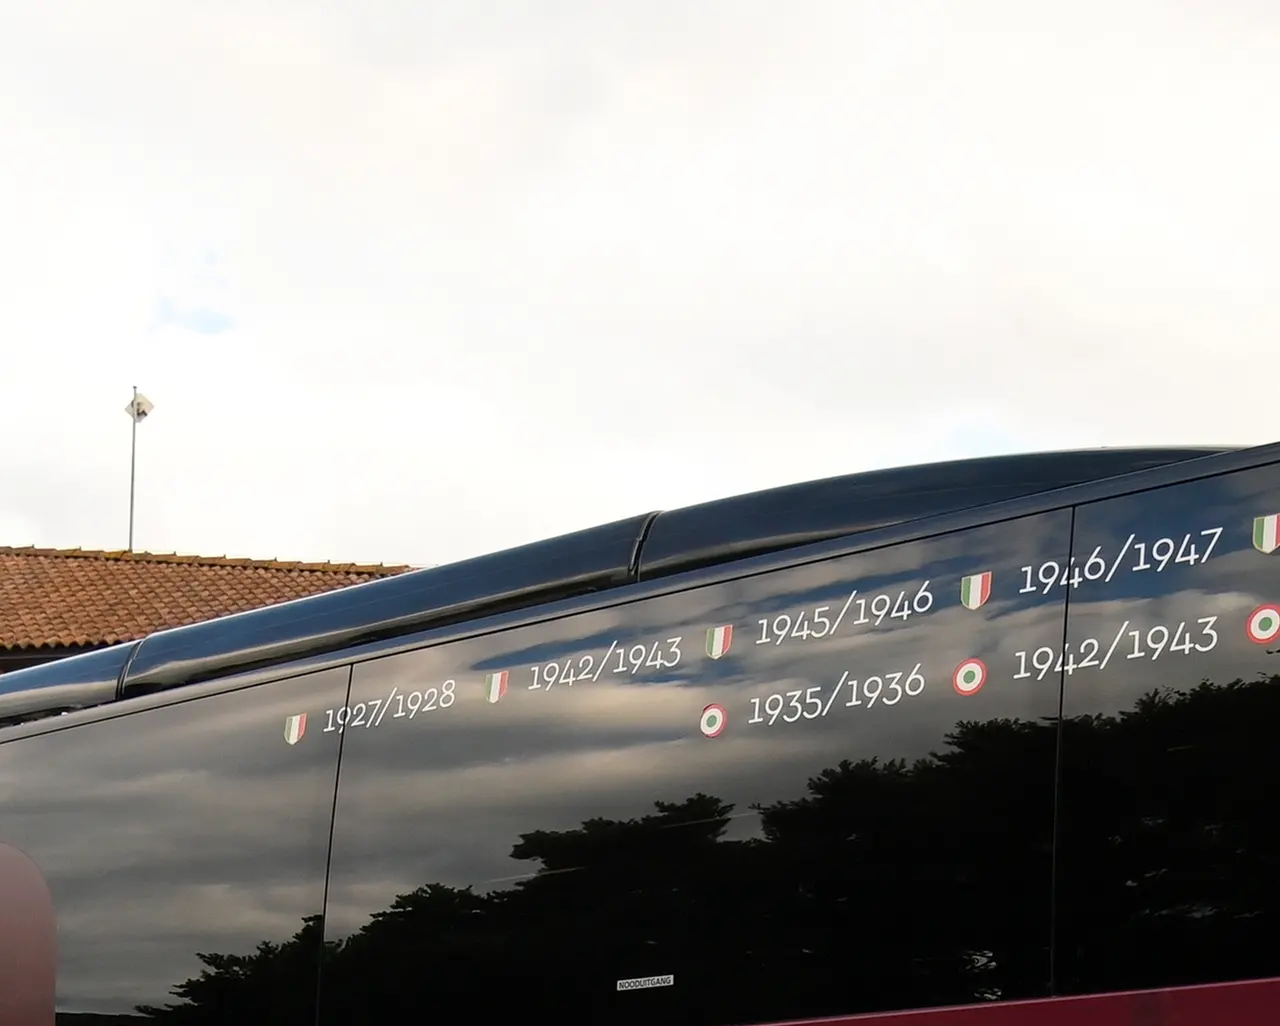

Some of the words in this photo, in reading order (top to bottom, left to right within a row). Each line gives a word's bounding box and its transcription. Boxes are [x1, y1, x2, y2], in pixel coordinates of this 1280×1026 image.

[1019, 527, 1224, 595] 1946/1947
[754, 580, 934, 646] 1945/1946
[527, 637, 683, 691] 1942/1943
[1013, 616, 1220, 681] 1942/1943
[323, 679, 456, 734] 1927/1928
[747, 663, 926, 726] 1935/1936
[618, 976, 671, 989] NOODUITGANG
